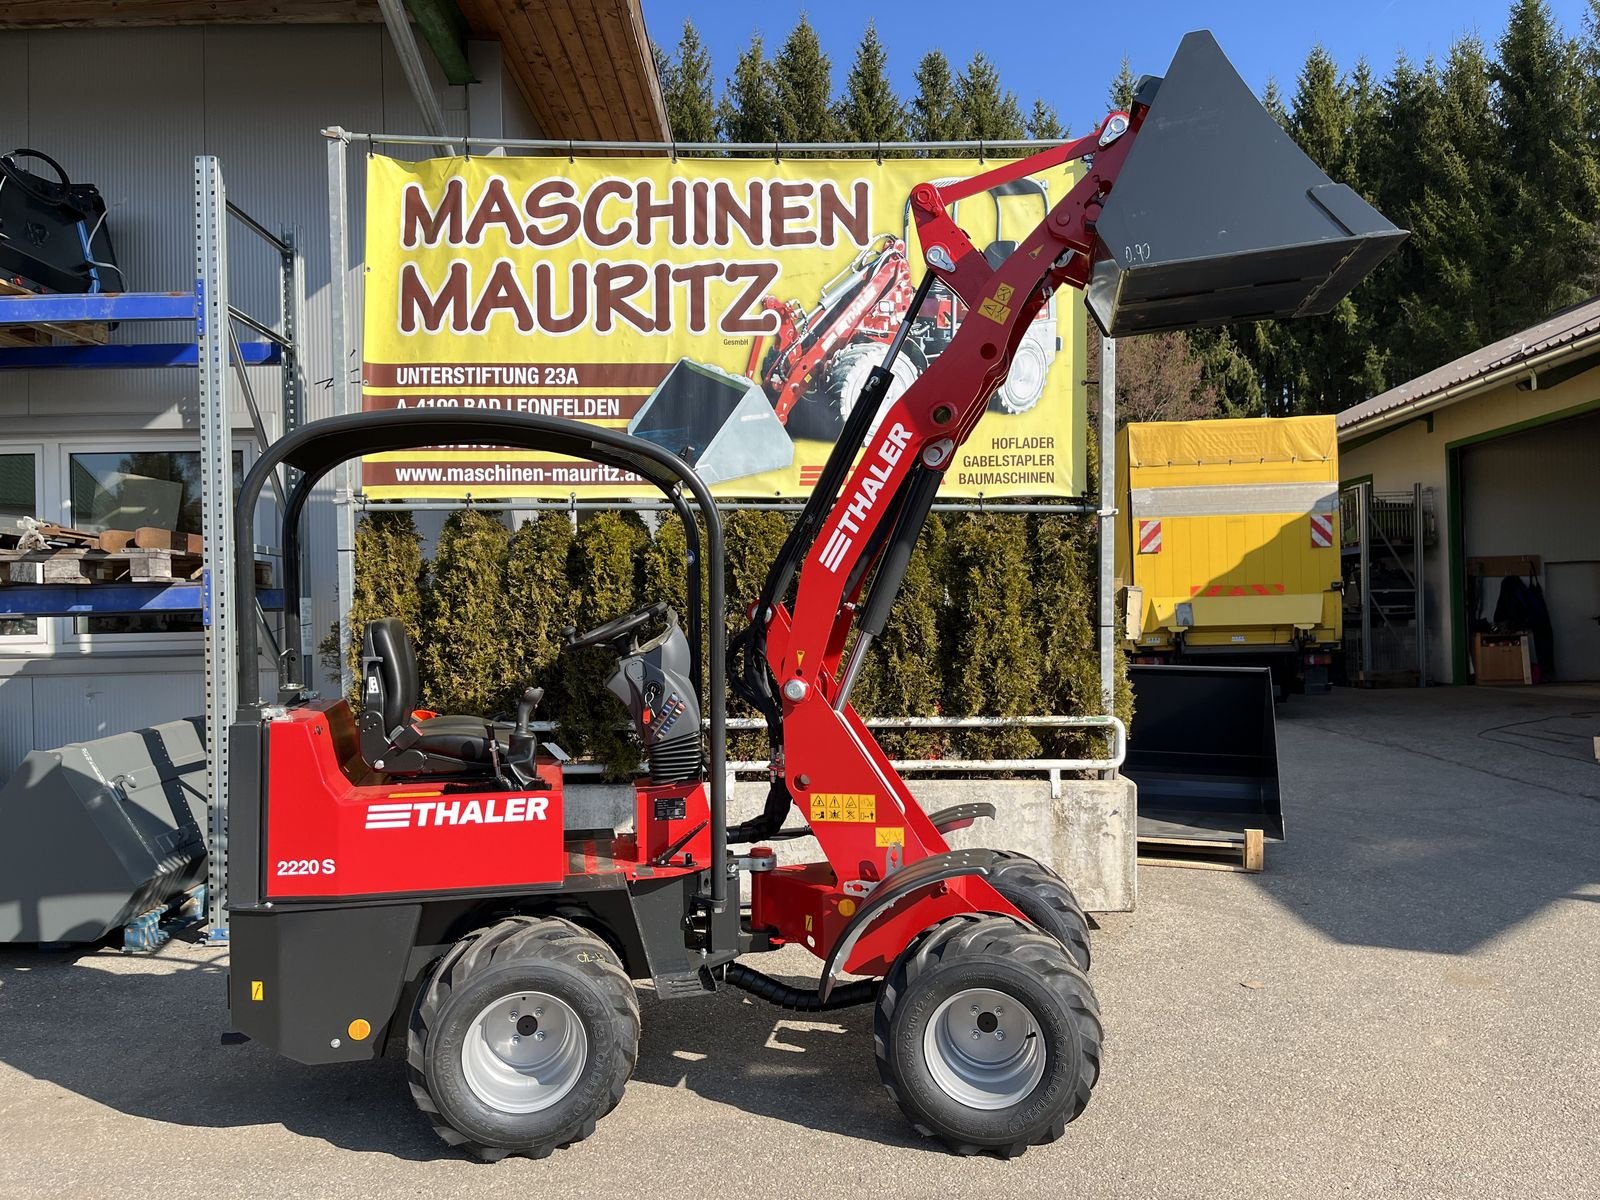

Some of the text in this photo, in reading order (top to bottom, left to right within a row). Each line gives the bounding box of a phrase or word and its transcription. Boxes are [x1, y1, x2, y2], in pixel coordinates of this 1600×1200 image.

[402, 178, 870, 248] MASCHINEN
[400, 261, 780, 333] MAURITZ
[723, 338, 749, 346] GesmbH
[396, 366, 579, 385] UNTERSTIFTUNG 23A
[508, 398, 620, 416] LEONFELDEN
[991, 436, 1055, 450] HOFLADER
[963, 454, 1055, 468] GABELSTAPLER
[837, 422, 913, 534] THALER
[958, 471, 1055, 485] BAUMASCHINEN
[413, 797, 550, 827] THALER
[276, 858, 336, 876] 2220 S
